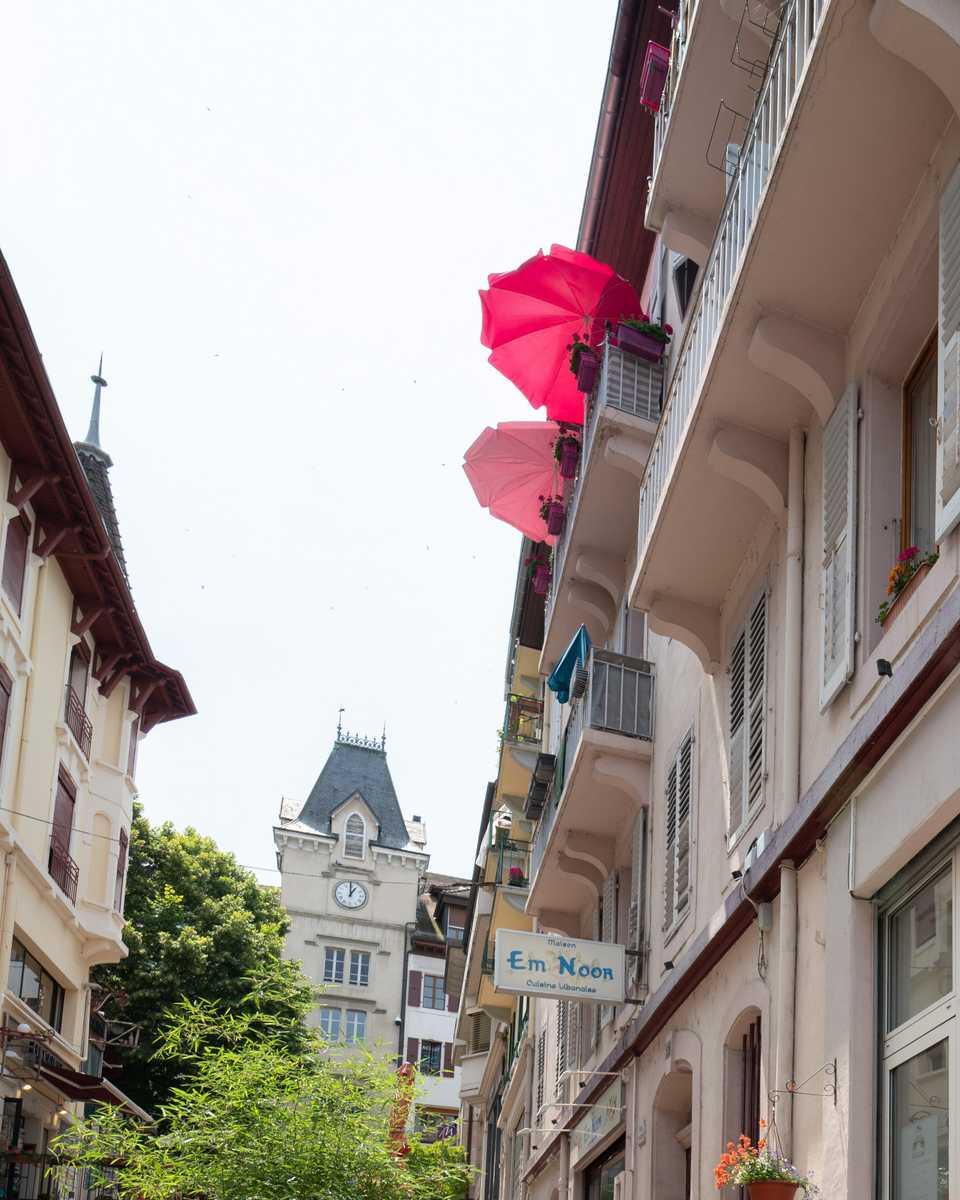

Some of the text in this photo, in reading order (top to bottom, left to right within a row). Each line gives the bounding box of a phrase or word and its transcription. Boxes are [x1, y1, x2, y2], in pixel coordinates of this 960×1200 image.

[547, 938, 577, 950] Maison
[507, 950, 547, 973] Em
[526, 979, 597, 994] Cuisine Libanaise
